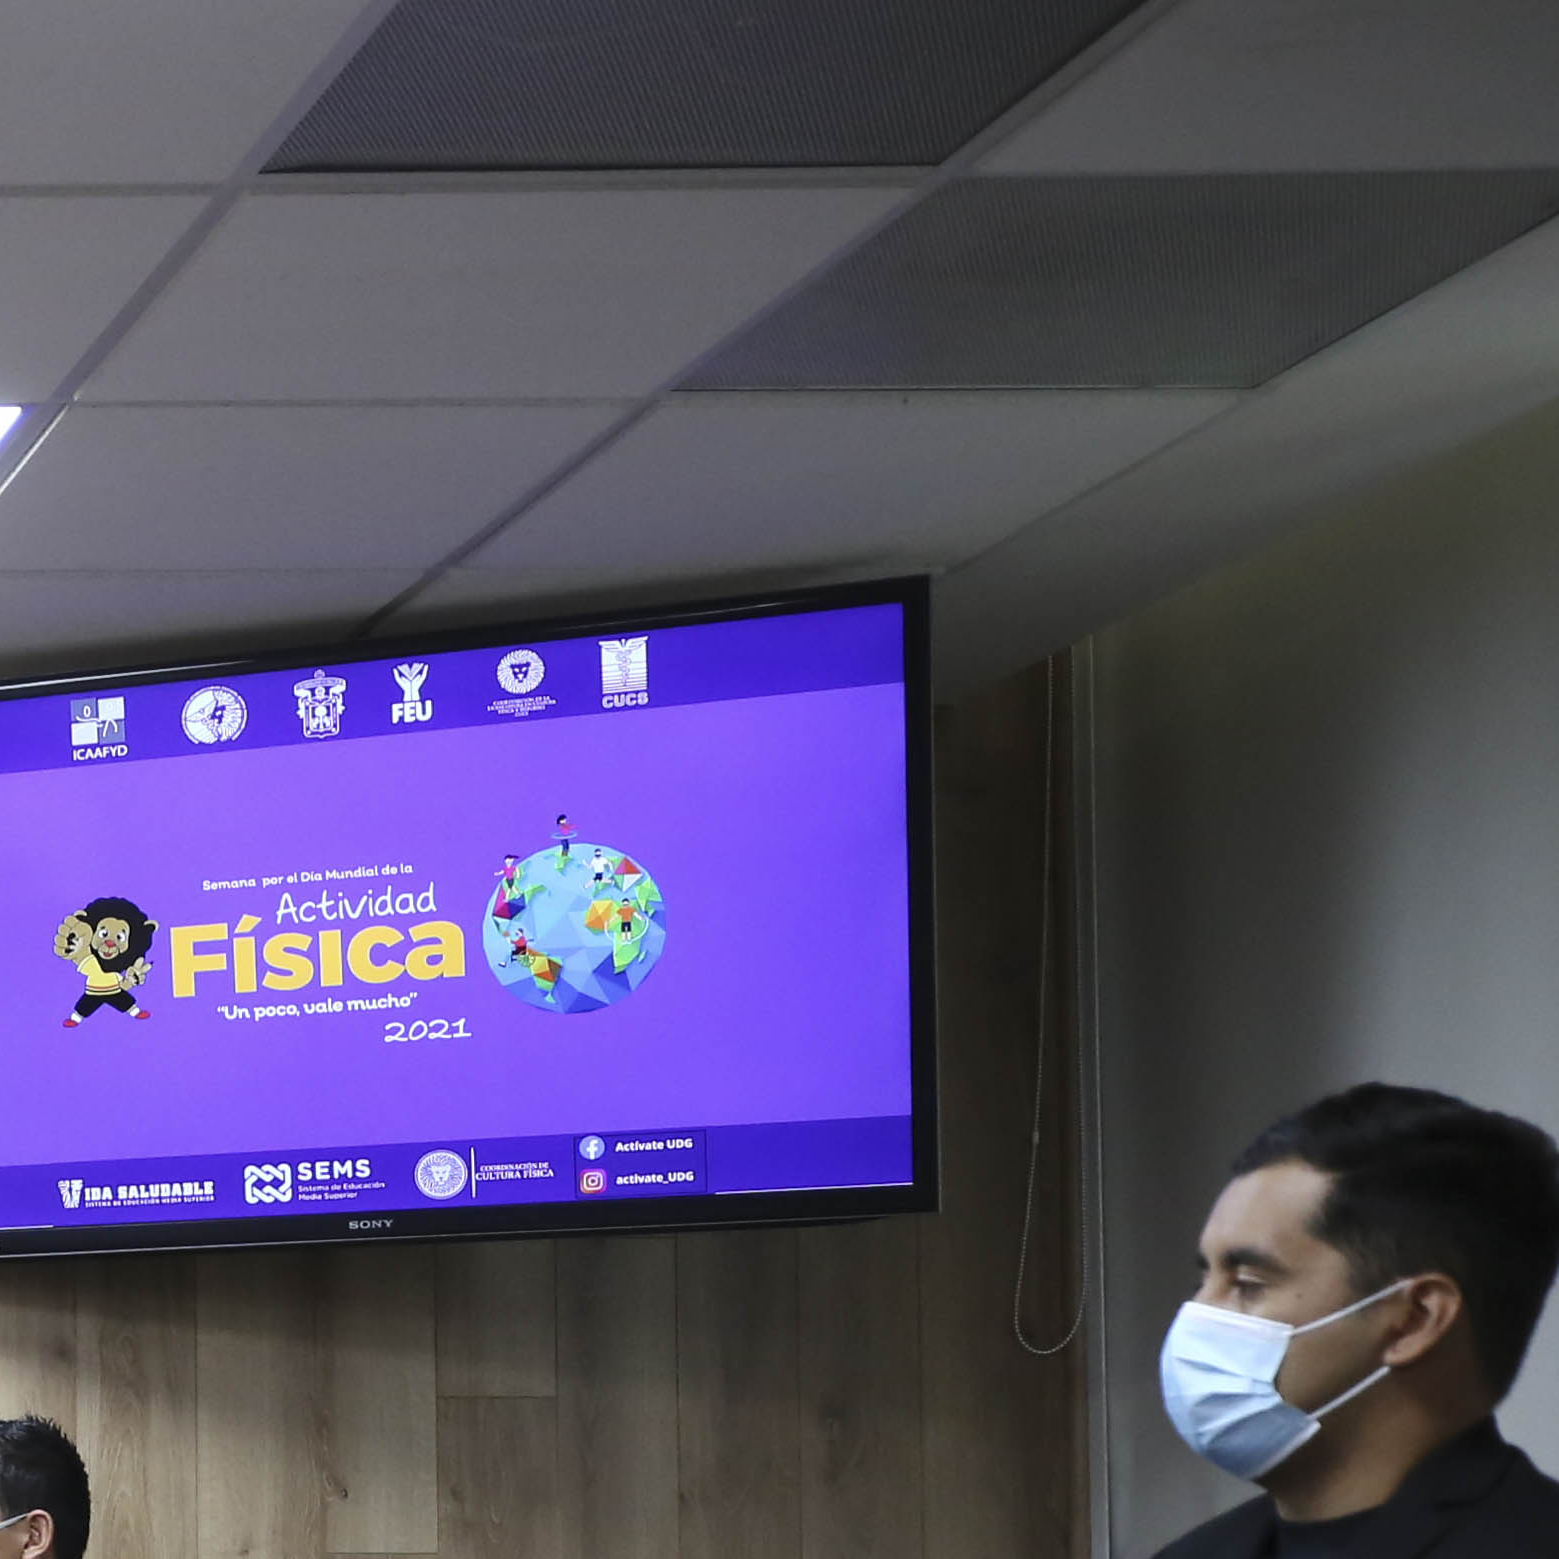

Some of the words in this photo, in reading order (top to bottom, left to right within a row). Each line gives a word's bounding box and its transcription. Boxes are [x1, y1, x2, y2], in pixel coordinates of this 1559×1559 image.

[602, 692, 649, 709] CUCS
[391, 699, 433, 724] FEU
[72, 744, 128, 761] ICAAFYD
[202, 878, 256, 891] Semana
[262, 875, 283, 888] por
[286, 872, 298, 884] el
[300, 870, 323, 882] Día
[325, 865, 379, 880] Mundial
[381, 864, 398, 876] de
[400, 863, 413, 874] la
[276, 881, 437, 925] Actividad
[170, 913, 466, 998] Física
[253, 1003, 300, 1021] poco,
[304, 998, 343, 1015] vale
[384, 1018, 472, 1043] 2021
[667, 1138, 694, 1149] UDG
[297, 1158, 371, 1181] SEMS
[475, 1170, 522, 1181] CULTURA
[522, 1168, 554, 1179] FÍSICA
[118, 1180, 214, 1199] SALUDABLE
[298, 1184, 329, 1192] Sistema
[331, 1183, 341, 1191] de
[324, 1192, 357, 1200] Superior
[348, 1219, 393, 1229] SONY
